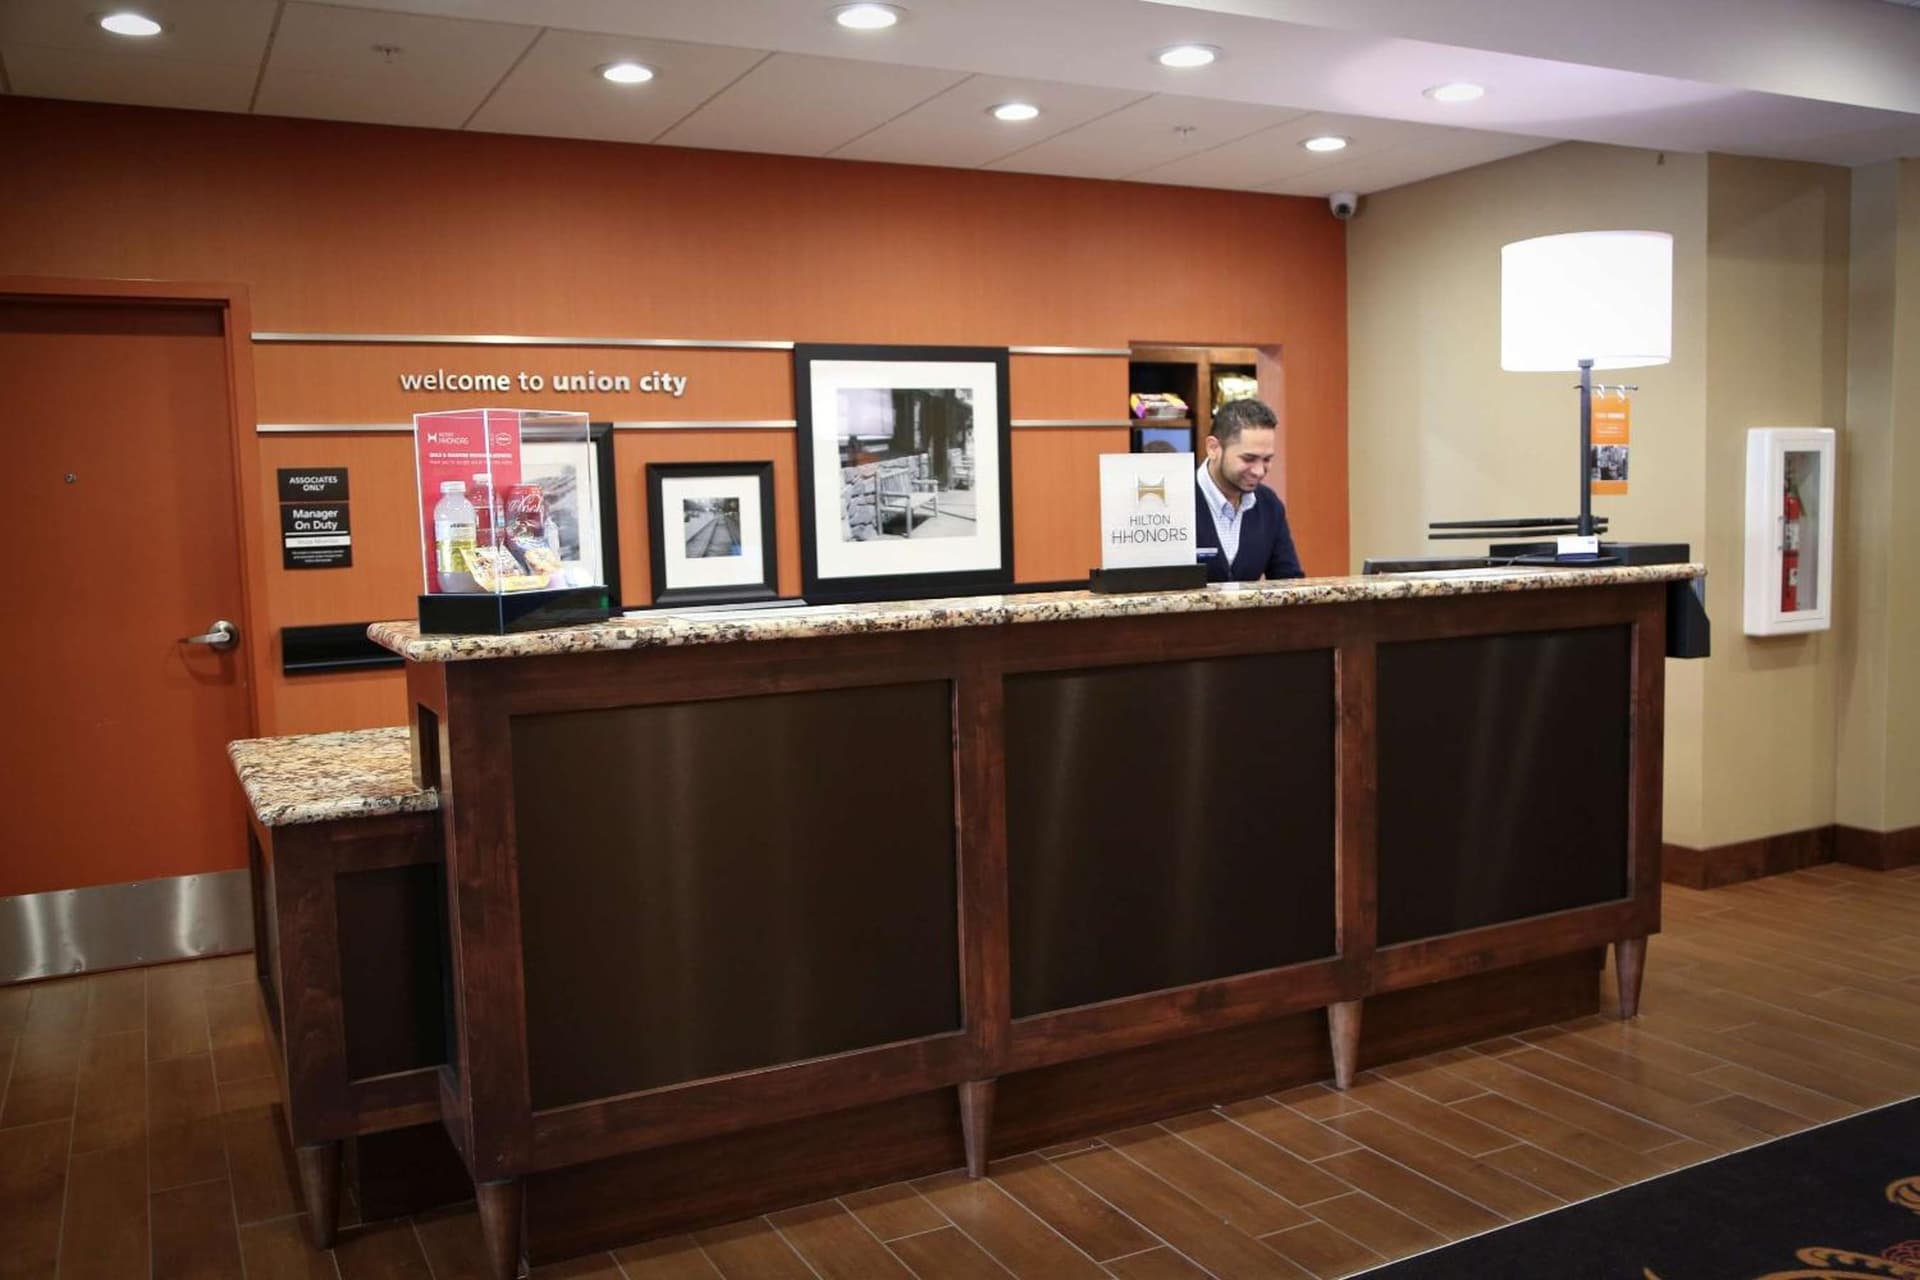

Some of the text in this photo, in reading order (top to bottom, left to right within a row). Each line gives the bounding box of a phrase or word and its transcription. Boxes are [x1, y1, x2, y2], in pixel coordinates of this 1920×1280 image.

[400, 369, 688, 397] welcome to union city
[289, 476, 338, 484] ASSOCIATES
[292, 509, 338, 520] Manager
[1129, 514, 1171, 527] HILTON
[295, 520, 338, 531] On Duty
[1111, 527, 1188, 545] HHONORS
